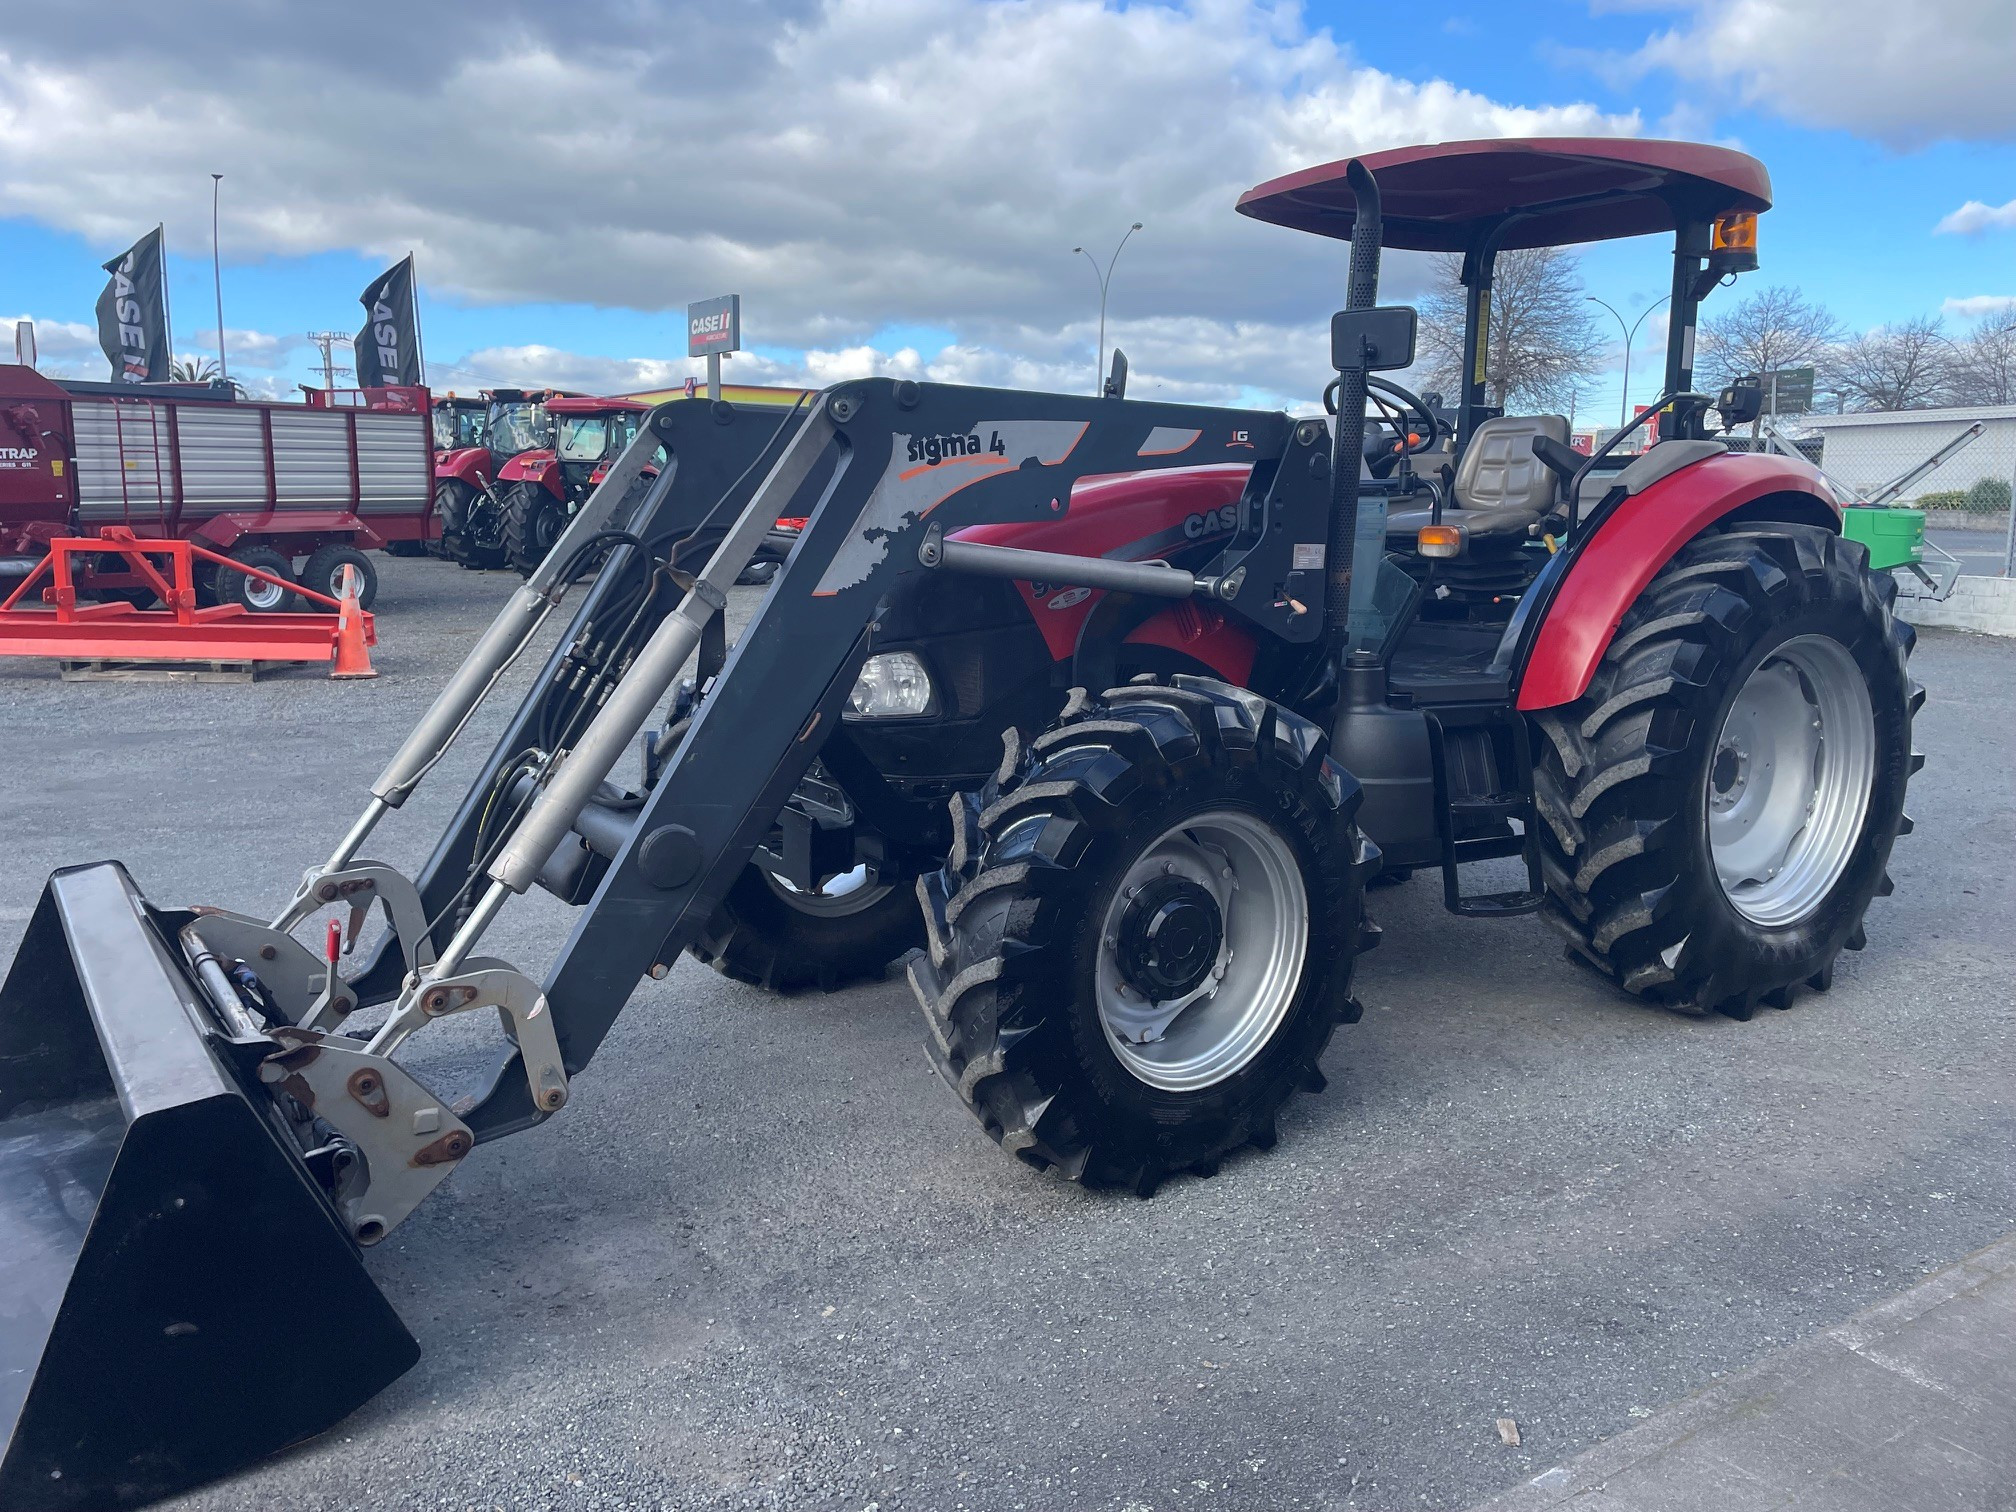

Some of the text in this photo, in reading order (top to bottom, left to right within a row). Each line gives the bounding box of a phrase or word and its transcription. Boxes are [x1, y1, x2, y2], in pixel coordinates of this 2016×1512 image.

[691, 314, 720, 335] CASE
[0, 447, 38, 460] TRAP
[907, 430, 1006, 466] sigma 4
